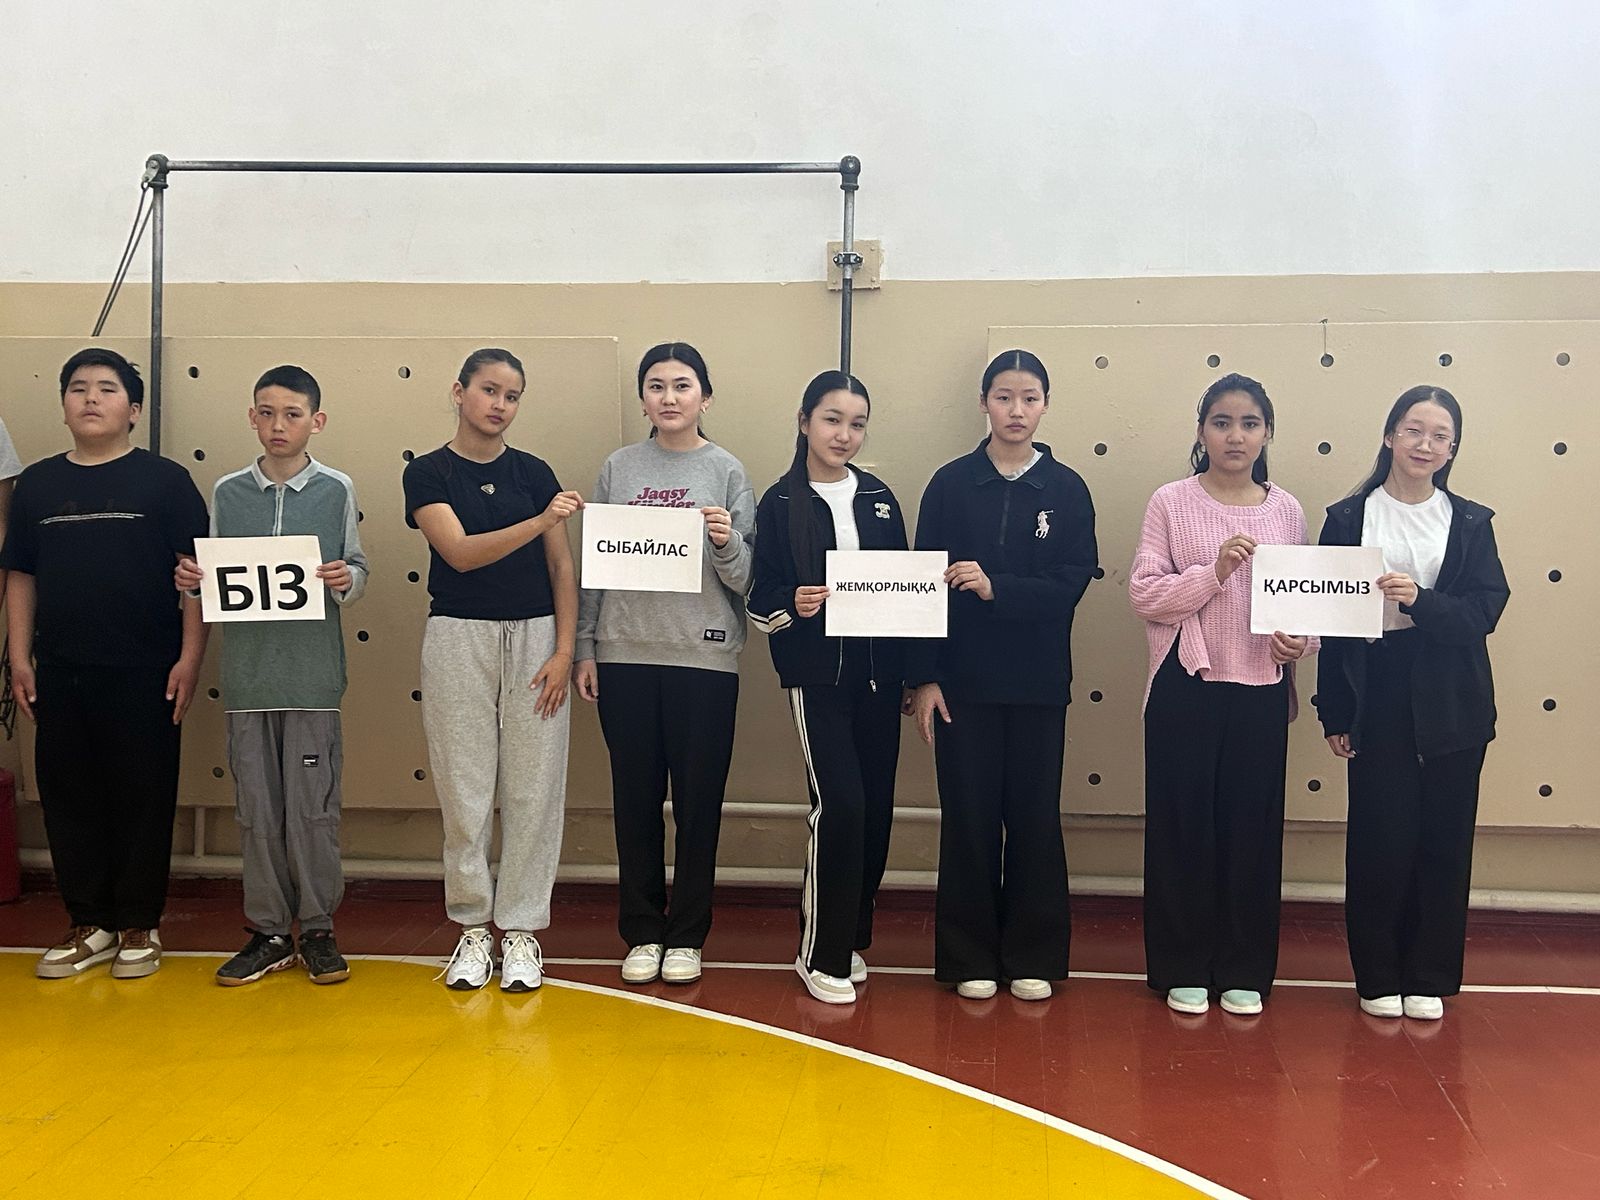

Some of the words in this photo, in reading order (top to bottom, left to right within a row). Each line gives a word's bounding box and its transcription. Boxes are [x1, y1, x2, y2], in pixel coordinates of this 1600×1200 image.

[637, 487, 690, 502] Jaqsy
[597, 538, 688, 557] СЫБАЙЛАС
[216, 563, 308, 611] БІЗ
[836, 582, 936, 594] ЖЕМҚОРЛЫҚҚА
[1264, 579, 1370, 595] ҚАРСЫМЫЗ
